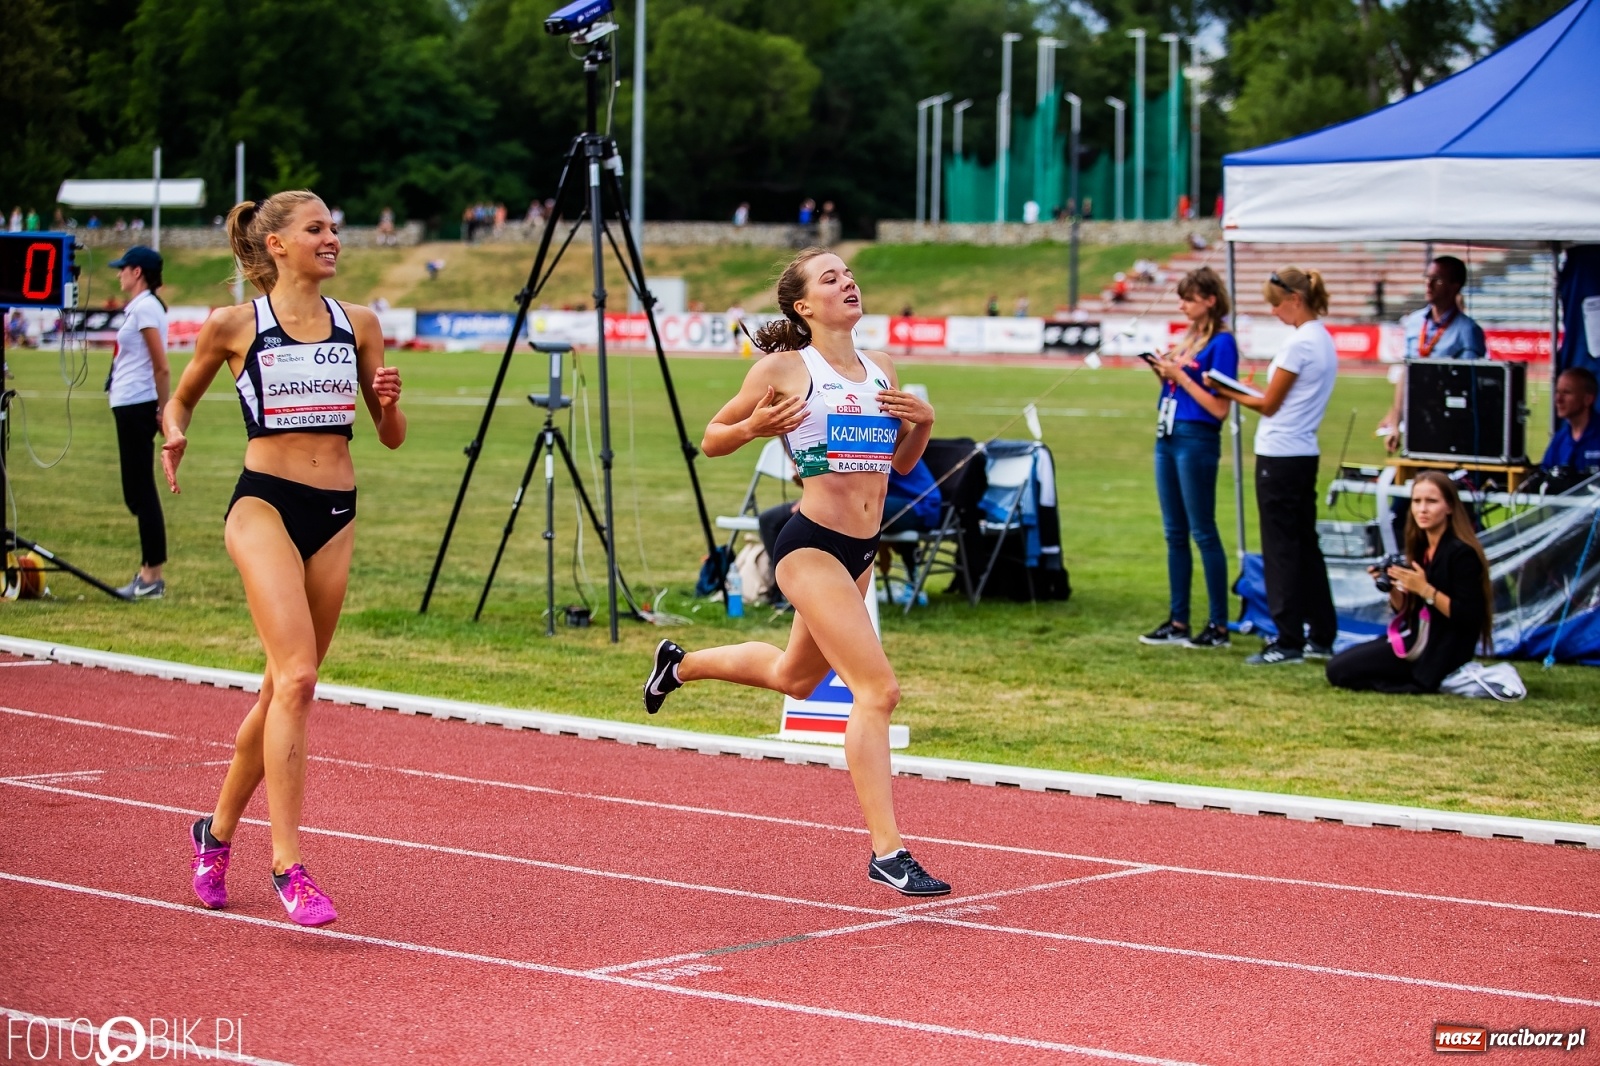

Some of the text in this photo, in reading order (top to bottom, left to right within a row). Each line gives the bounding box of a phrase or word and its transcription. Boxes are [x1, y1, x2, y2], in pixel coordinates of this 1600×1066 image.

[22, 242, 57, 300] 0
[314, 347, 352, 365] 662
[268, 379, 353, 397] SARNECKA
[838, 405, 860, 413] ORLEN
[277, 413, 346, 426] RACIBÓRZ 2019
[838, 460, 878, 472] RACIBÓRZ
